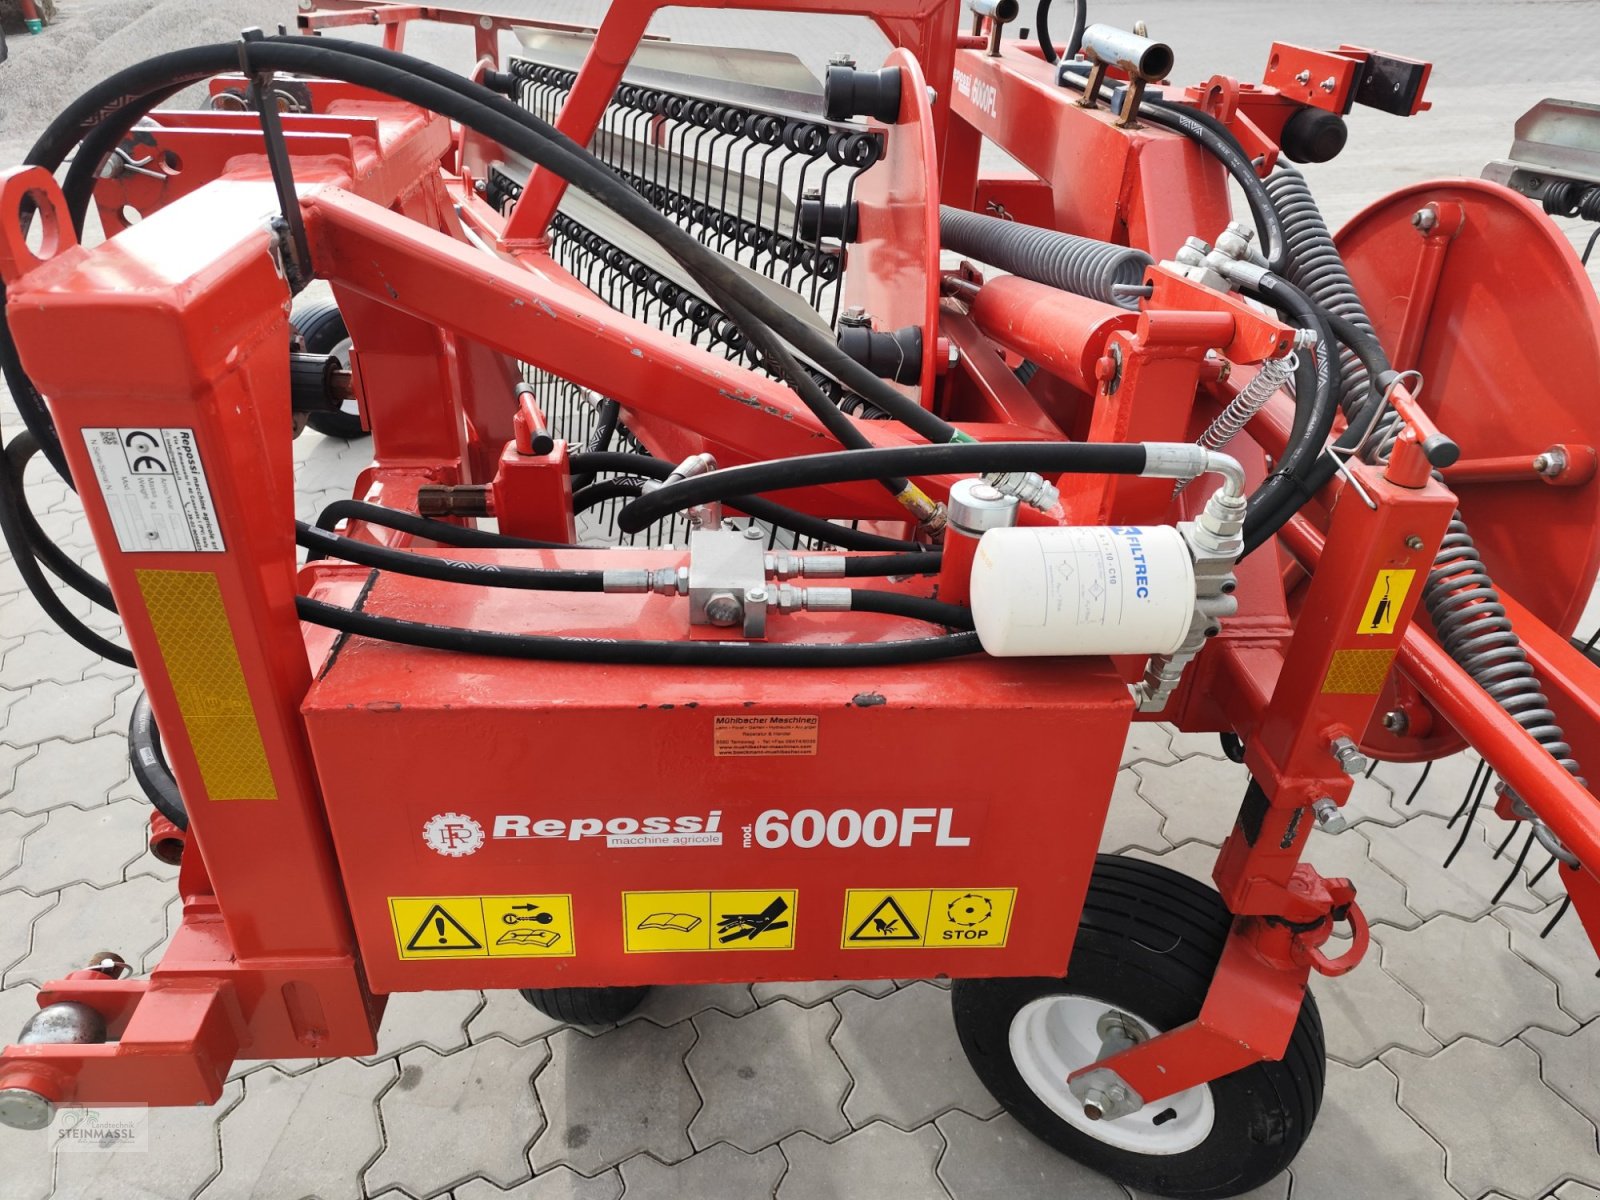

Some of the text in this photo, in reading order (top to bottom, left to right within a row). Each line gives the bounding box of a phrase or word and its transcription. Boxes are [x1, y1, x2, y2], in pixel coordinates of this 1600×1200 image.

[180, 431, 218, 549] Repossi macchine agricole srl
[1127, 537, 1149, 599] FILTREC
[493, 810, 722, 841] Repossi
[611, 834, 720, 846] macchine agricole
[741, 808, 971, 849] mod. 6000FL
[942, 929, 989, 940] STOP
